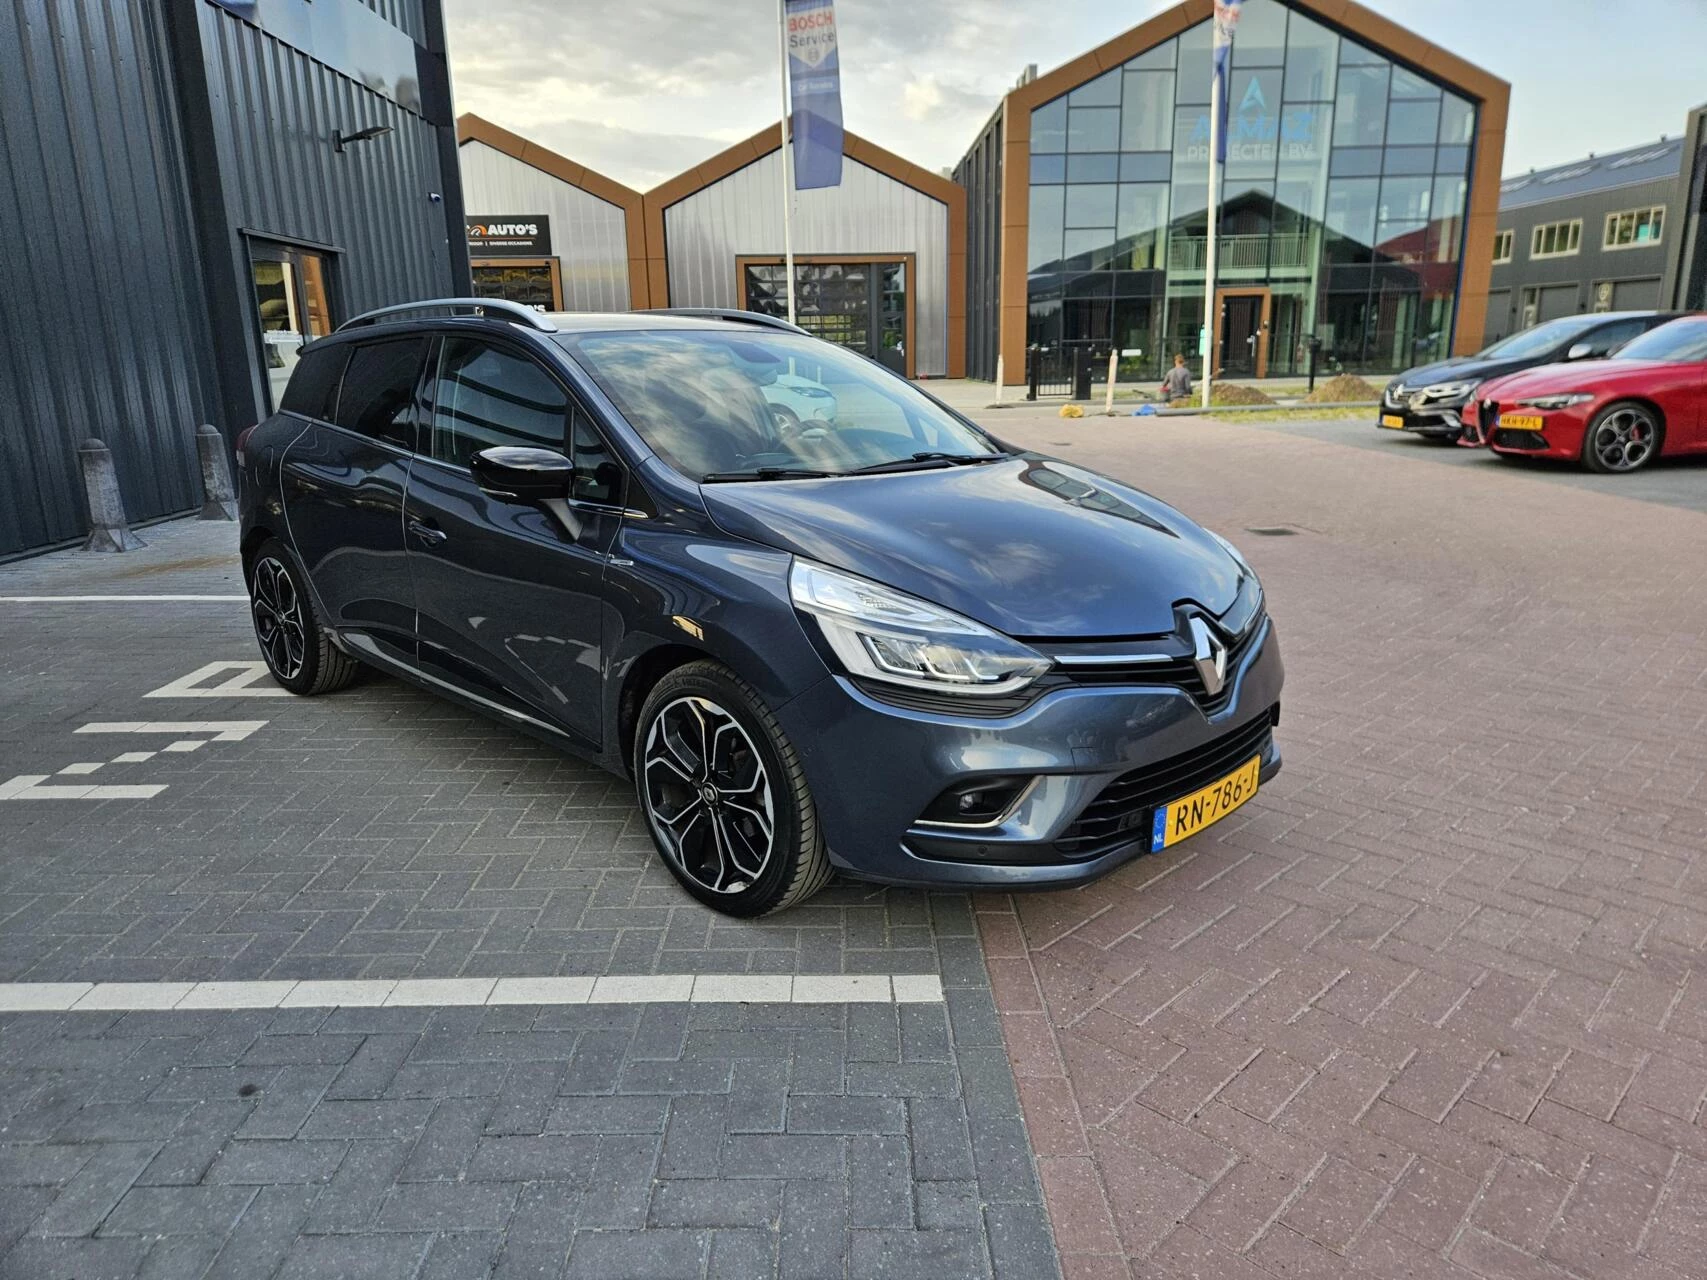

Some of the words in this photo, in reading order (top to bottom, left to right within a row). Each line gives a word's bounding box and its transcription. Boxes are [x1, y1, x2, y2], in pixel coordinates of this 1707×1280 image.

[789, 11, 833, 32] BOSCH
[789, 31, 835, 48] Service
[487, 224, 538, 236] AUTO'S
[1175, 765, 1255, 836] RN-786-J
[1153, 833, 1163, 844] NL
